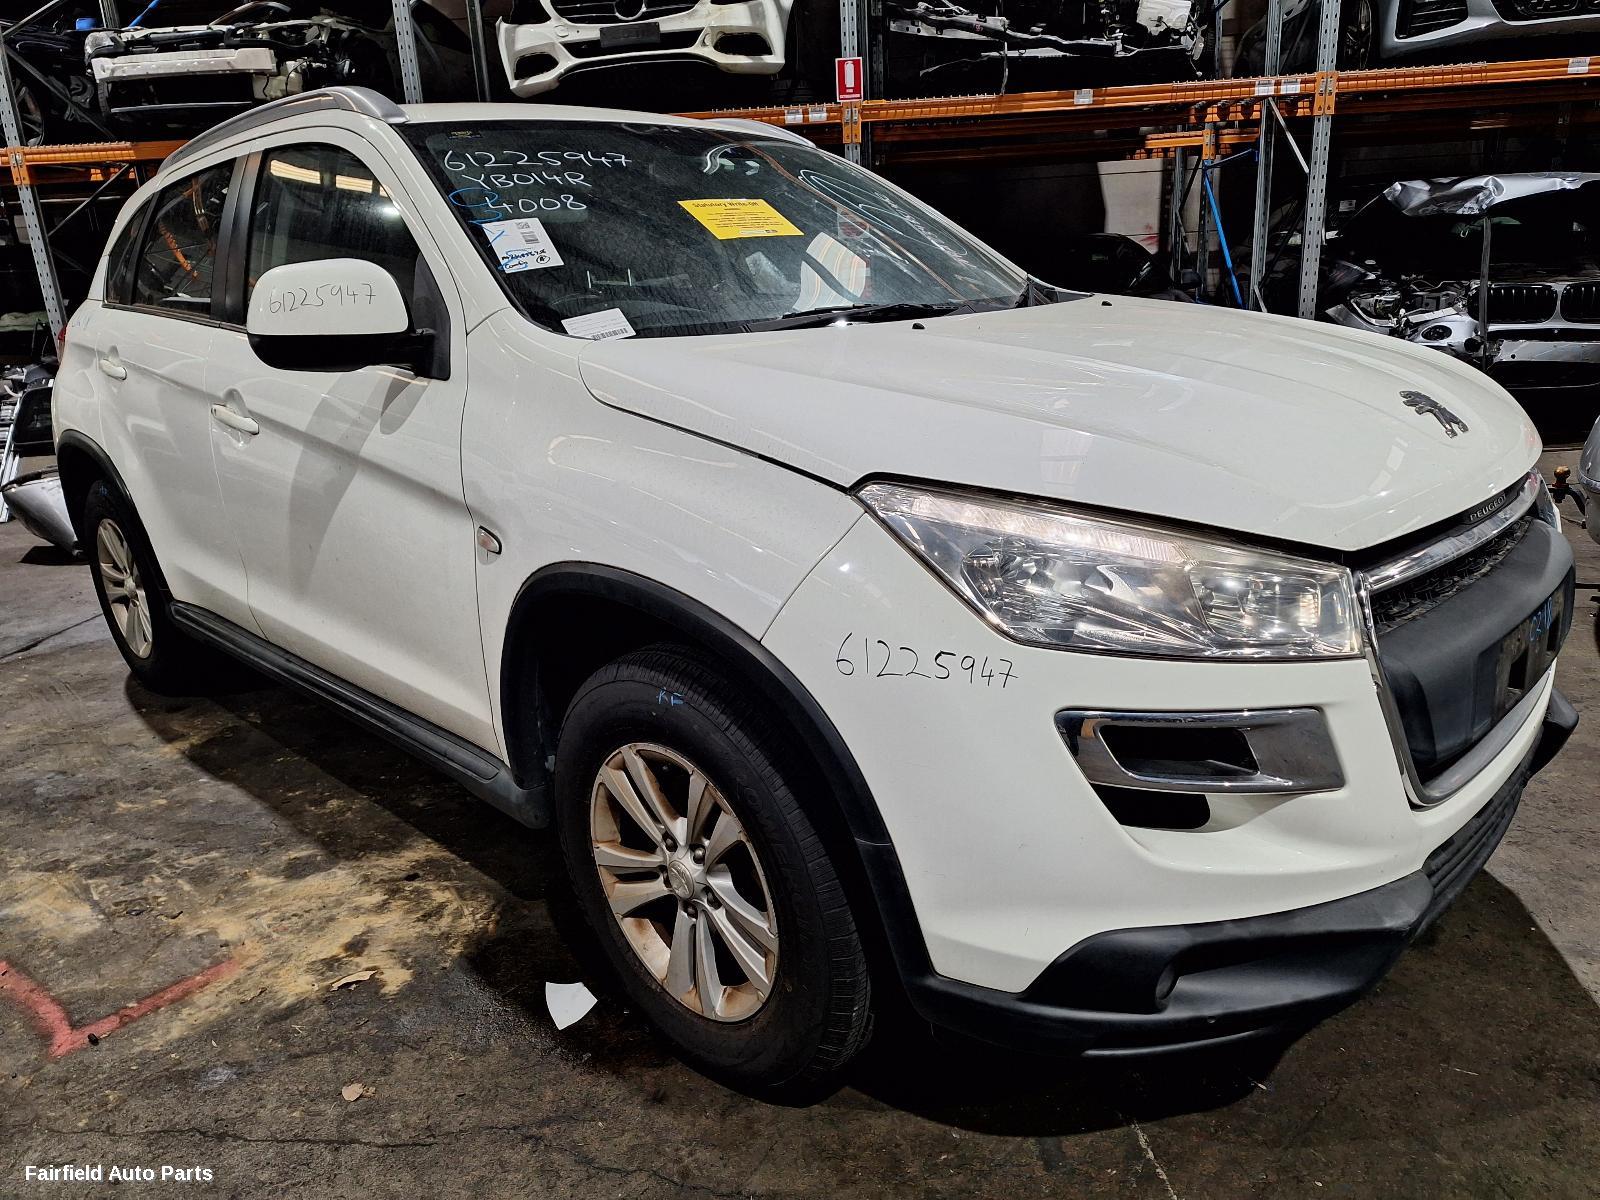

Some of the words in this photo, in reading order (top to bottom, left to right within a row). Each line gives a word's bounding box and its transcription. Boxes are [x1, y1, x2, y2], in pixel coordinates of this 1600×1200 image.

[444, 150, 632, 171] 61225947
[485, 194, 587, 213] 4008
[269, 282, 377, 313] 61225947
[1469, 493, 1508, 521] PEUGEOT
[836, 632, 1020, 689] 61225947
